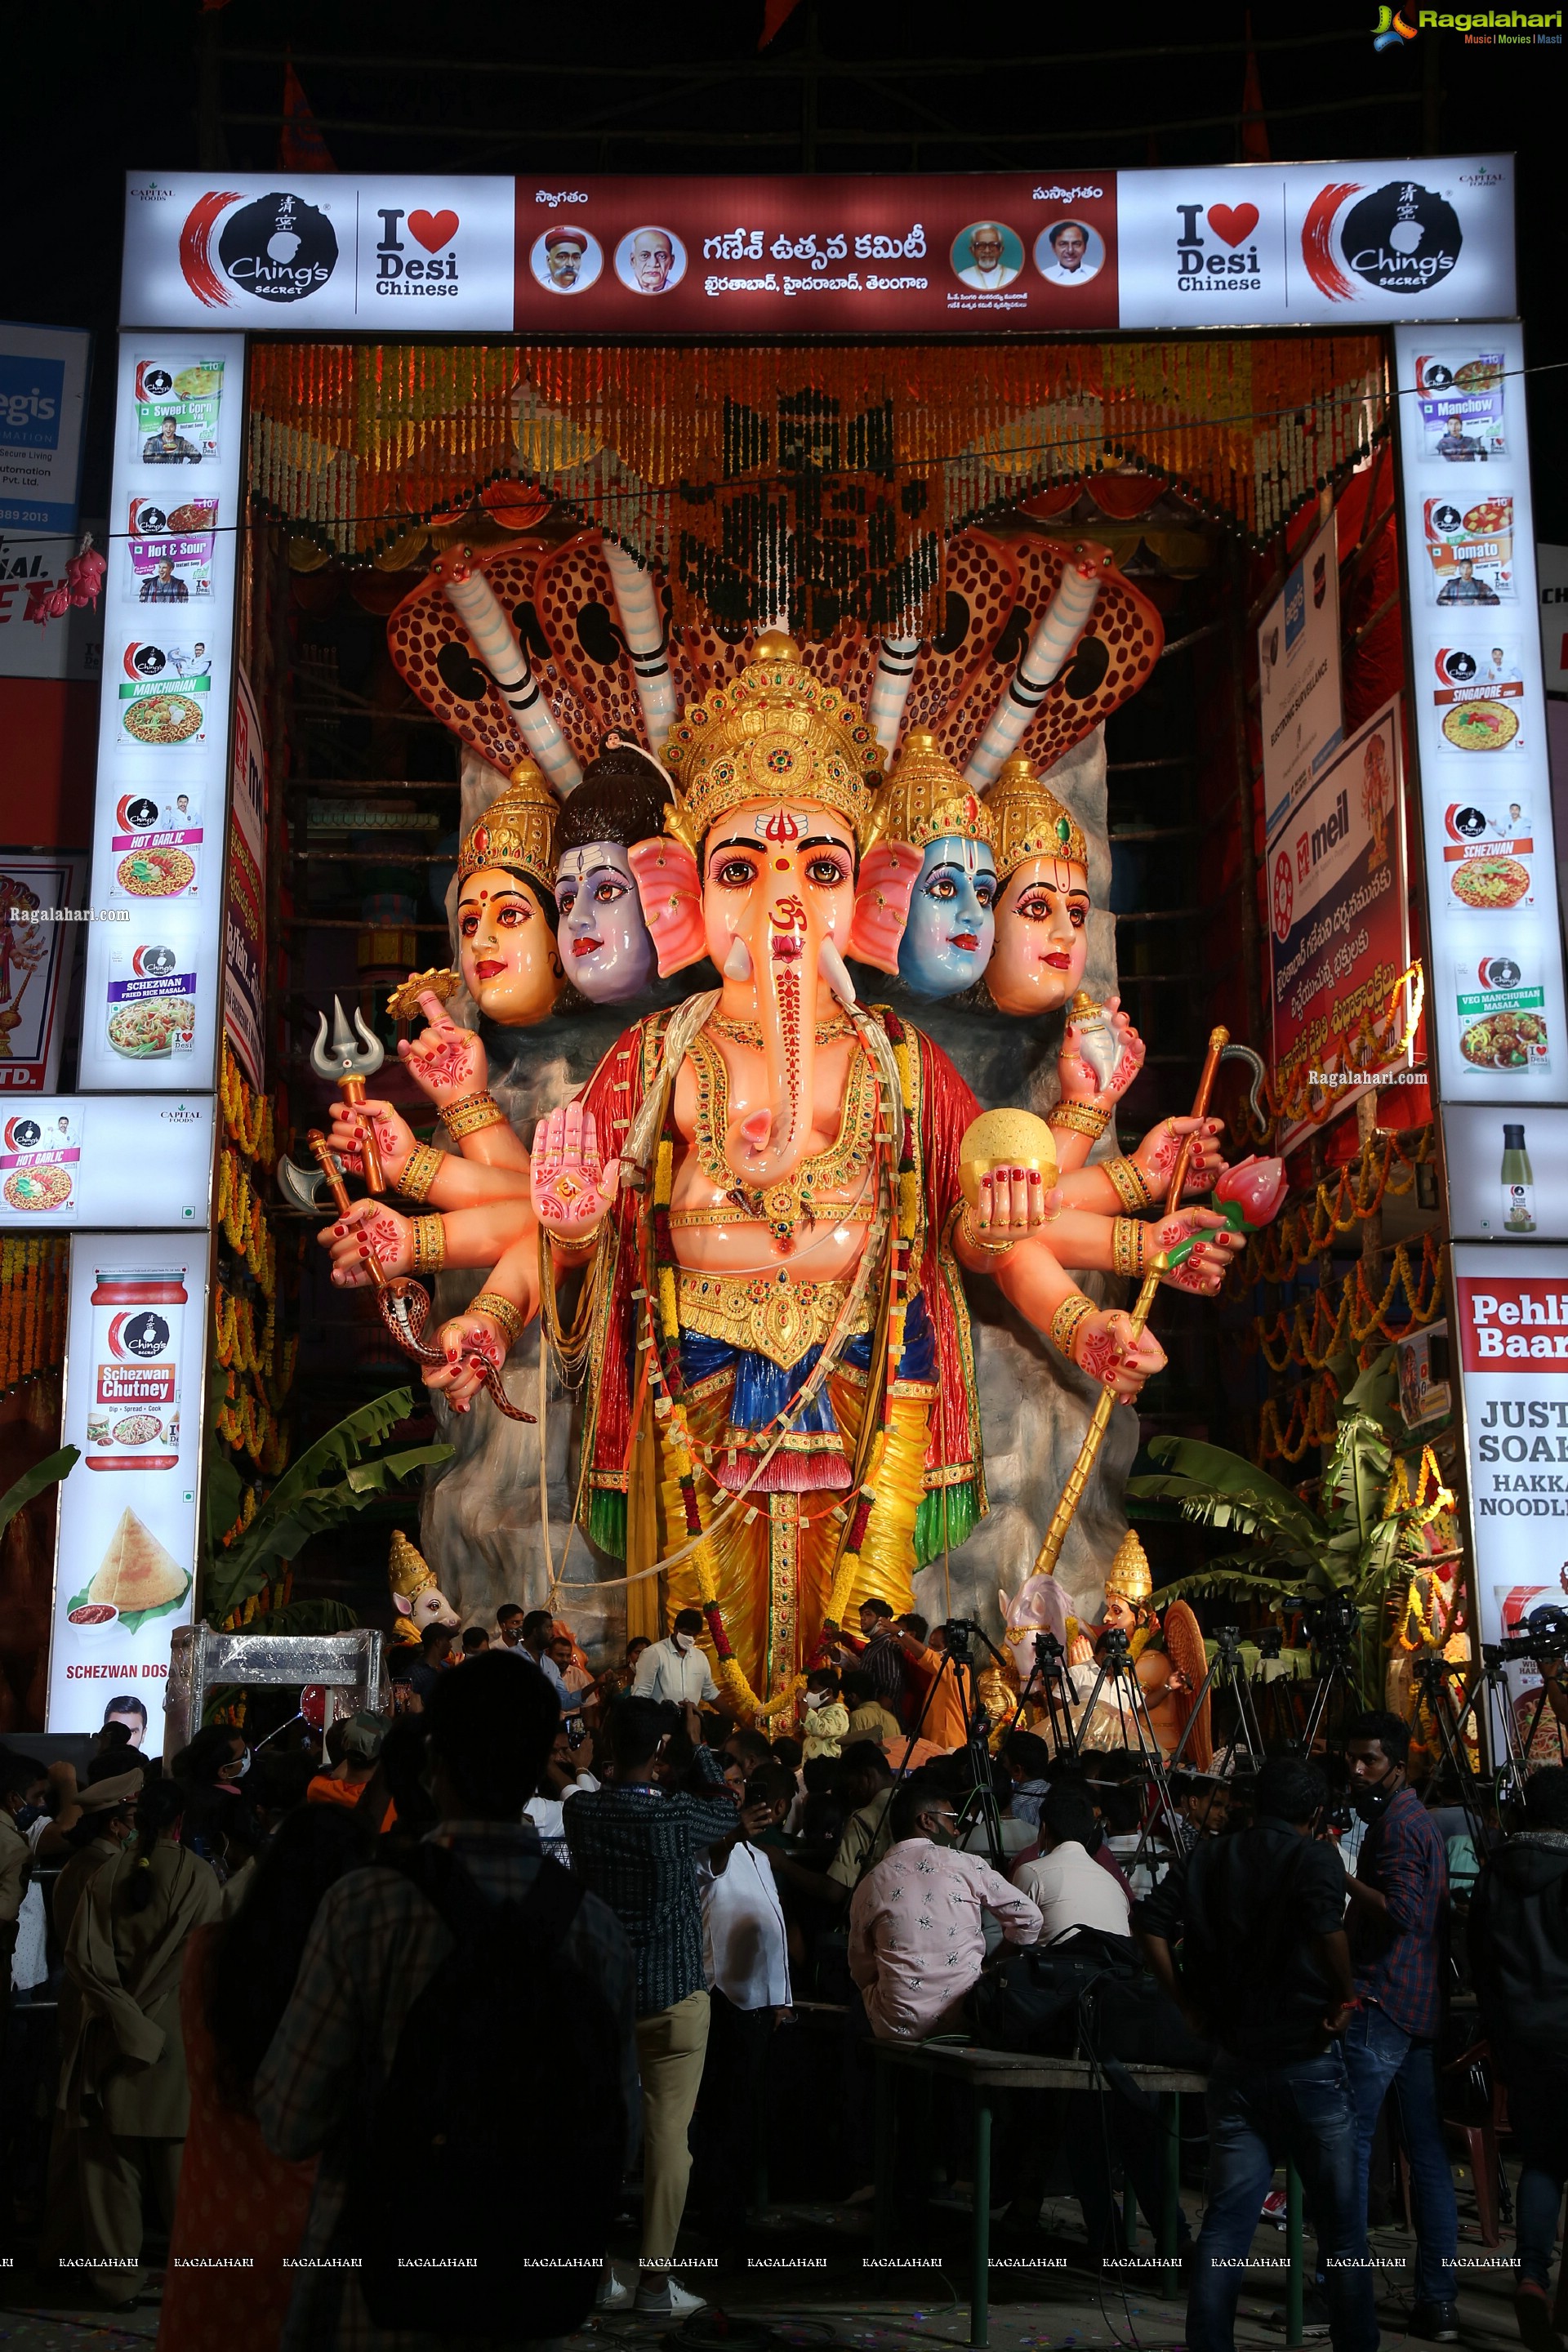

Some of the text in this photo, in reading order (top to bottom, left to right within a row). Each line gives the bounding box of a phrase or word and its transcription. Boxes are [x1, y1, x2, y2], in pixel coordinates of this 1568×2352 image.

[1459, 174, 1505, 182] CAPITAL
[130, 189, 175, 197] CAPITAL
[535, 189, 589, 207] స్వాగతం
[1032, 185, 1103, 204] సుస్వాగతం
[376, 209, 404, 251] I
[1176, 204, 1205, 247] I
[702, 223, 927, 270] గణేశ్ ఉత్సవ కమిటీ
[376, 253, 459, 281] Desi
[1177, 247, 1261, 275] Desi
[1351, 251, 1455, 277] Ching's
[228, 257, 328, 287] Ching's
[376, 281, 459, 297] Chinese
[704, 273, 929, 296] ఖైరతాబాద్, హైదరాబాద్, తెలంగాణ
[1177, 277, 1262, 292] Chinese
[1379, 275, 1429, 287] SECRET
[254, 285, 303, 295] SECRET
[154, 403, 212, 416] Sweet Corn
[1437, 399, 1493, 416] Manchow
[0, 448, 52, 462] Secure Living
[2, 476, 39, 487] Pvt. Ltd.
[21, 511, 48, 523] 2013
[148, 542, 207, 558] Hot & Sour
[1451, 542, 1499, 561] Tomato
[133, 679, 197, 697] MANCHURIAN
[1452, 684, 1503, 702] SINGAPORE
[1270, 693, 1303, 748] ELECTRONIC
[1303, 657, 1329, 702] SURVEILLANCE
[1312, 788, 1349, 866] meil
[131, 831, 185, 849] HOT GARLIC
[1463, 841, 1515, 859] SCHEZWAN
[146, 964, 173, 973] Ching's
[126, 978, 183, 991] SCHEZWAN
[142, 989, 158, 997] RICE
[158, 987, 187, 996] MASALA
[1462, 989, 1541, 1004] VEG MANCHURIAN
[1483, 1000, 1520, 1011] MASALA
[174, 1032, 181, 1042] I
[16, 1151, 65, 1166] HOT GARLIC
[1471, 1294, 1568, 1325] Pehli
[127, 1339, 167, 1352] Ching's
[103, 1367, 169, 1381] Schezwan
[102, 1381, 169, 1400] Chutney
[109, 1405, 118, 1413] Dip
[123, 1405, 143, 1413] Spread
[1481, 1401, 1568, 1428] JUST
[66, 1664, 137, 1679] SCHEZWAN
